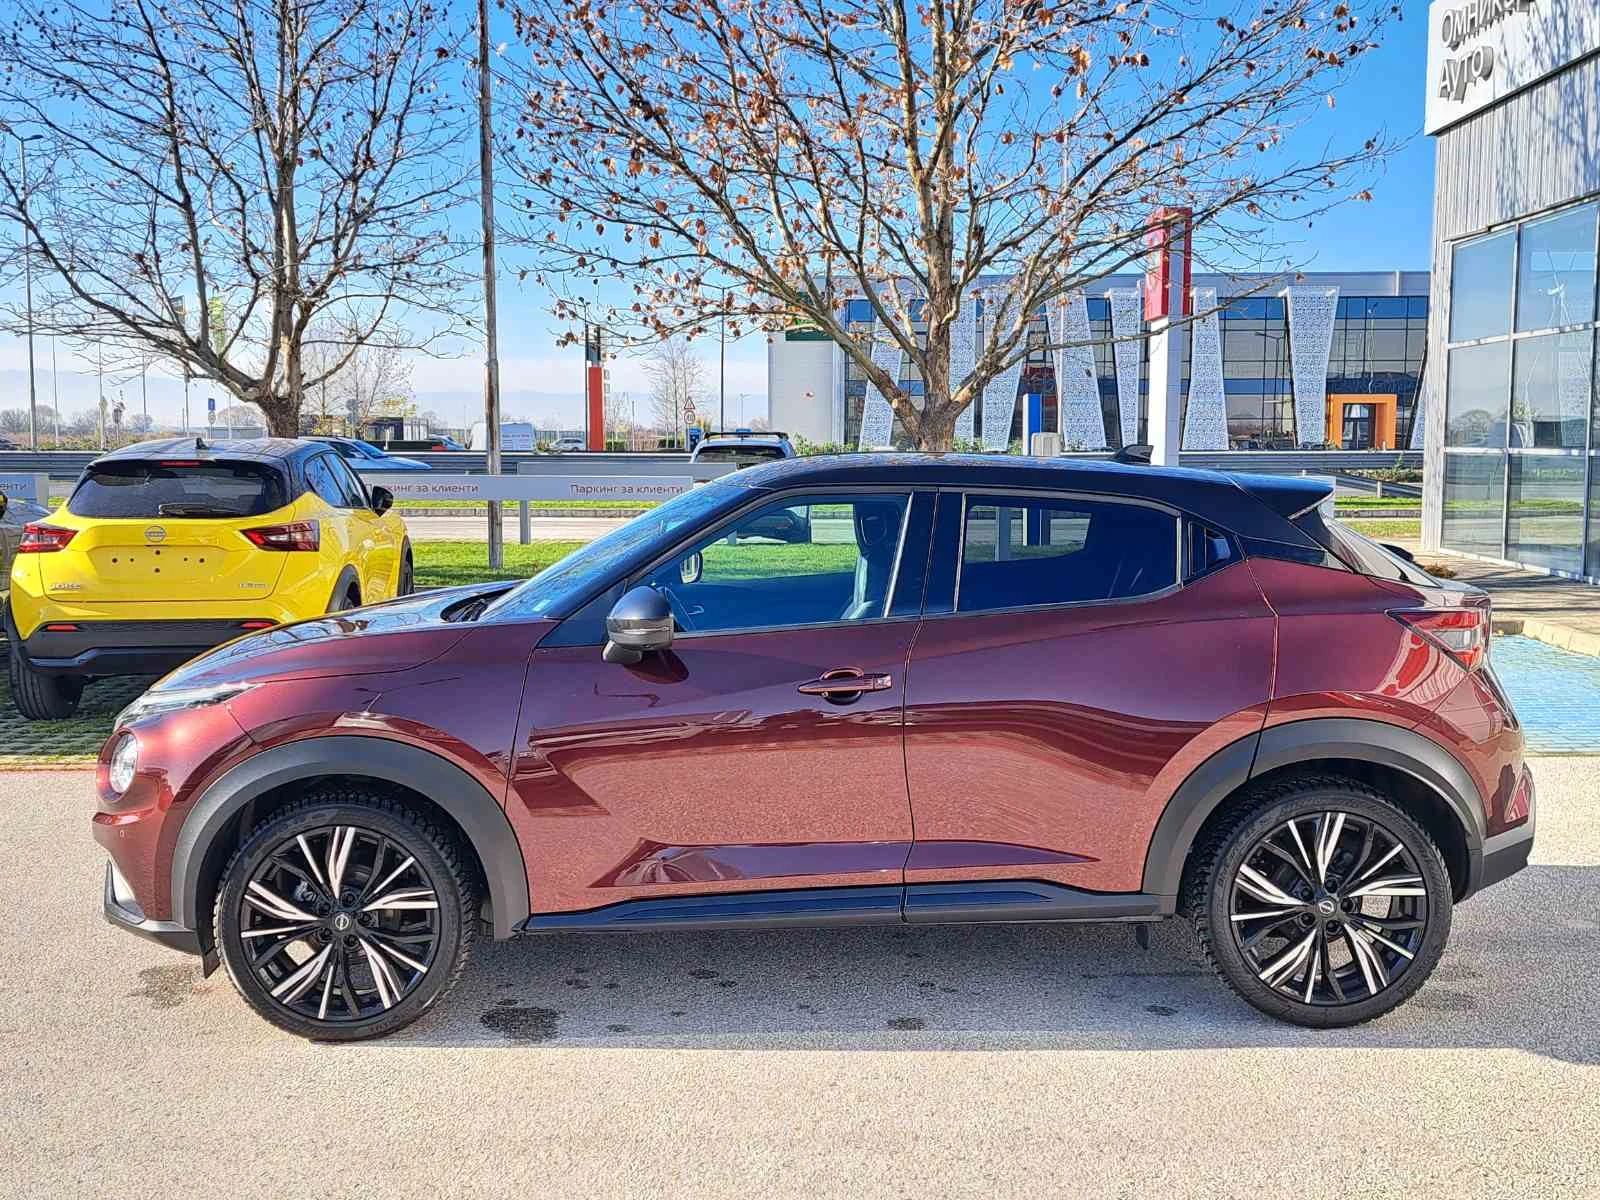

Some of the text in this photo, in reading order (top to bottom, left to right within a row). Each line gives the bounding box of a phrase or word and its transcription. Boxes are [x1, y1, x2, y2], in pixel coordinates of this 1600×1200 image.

[415, 484, 429, 493] за
[431, 484, 479, 493] клиенти
[570, 484, 617, 496] Паркинг
[621, 486, 634, 494] за
